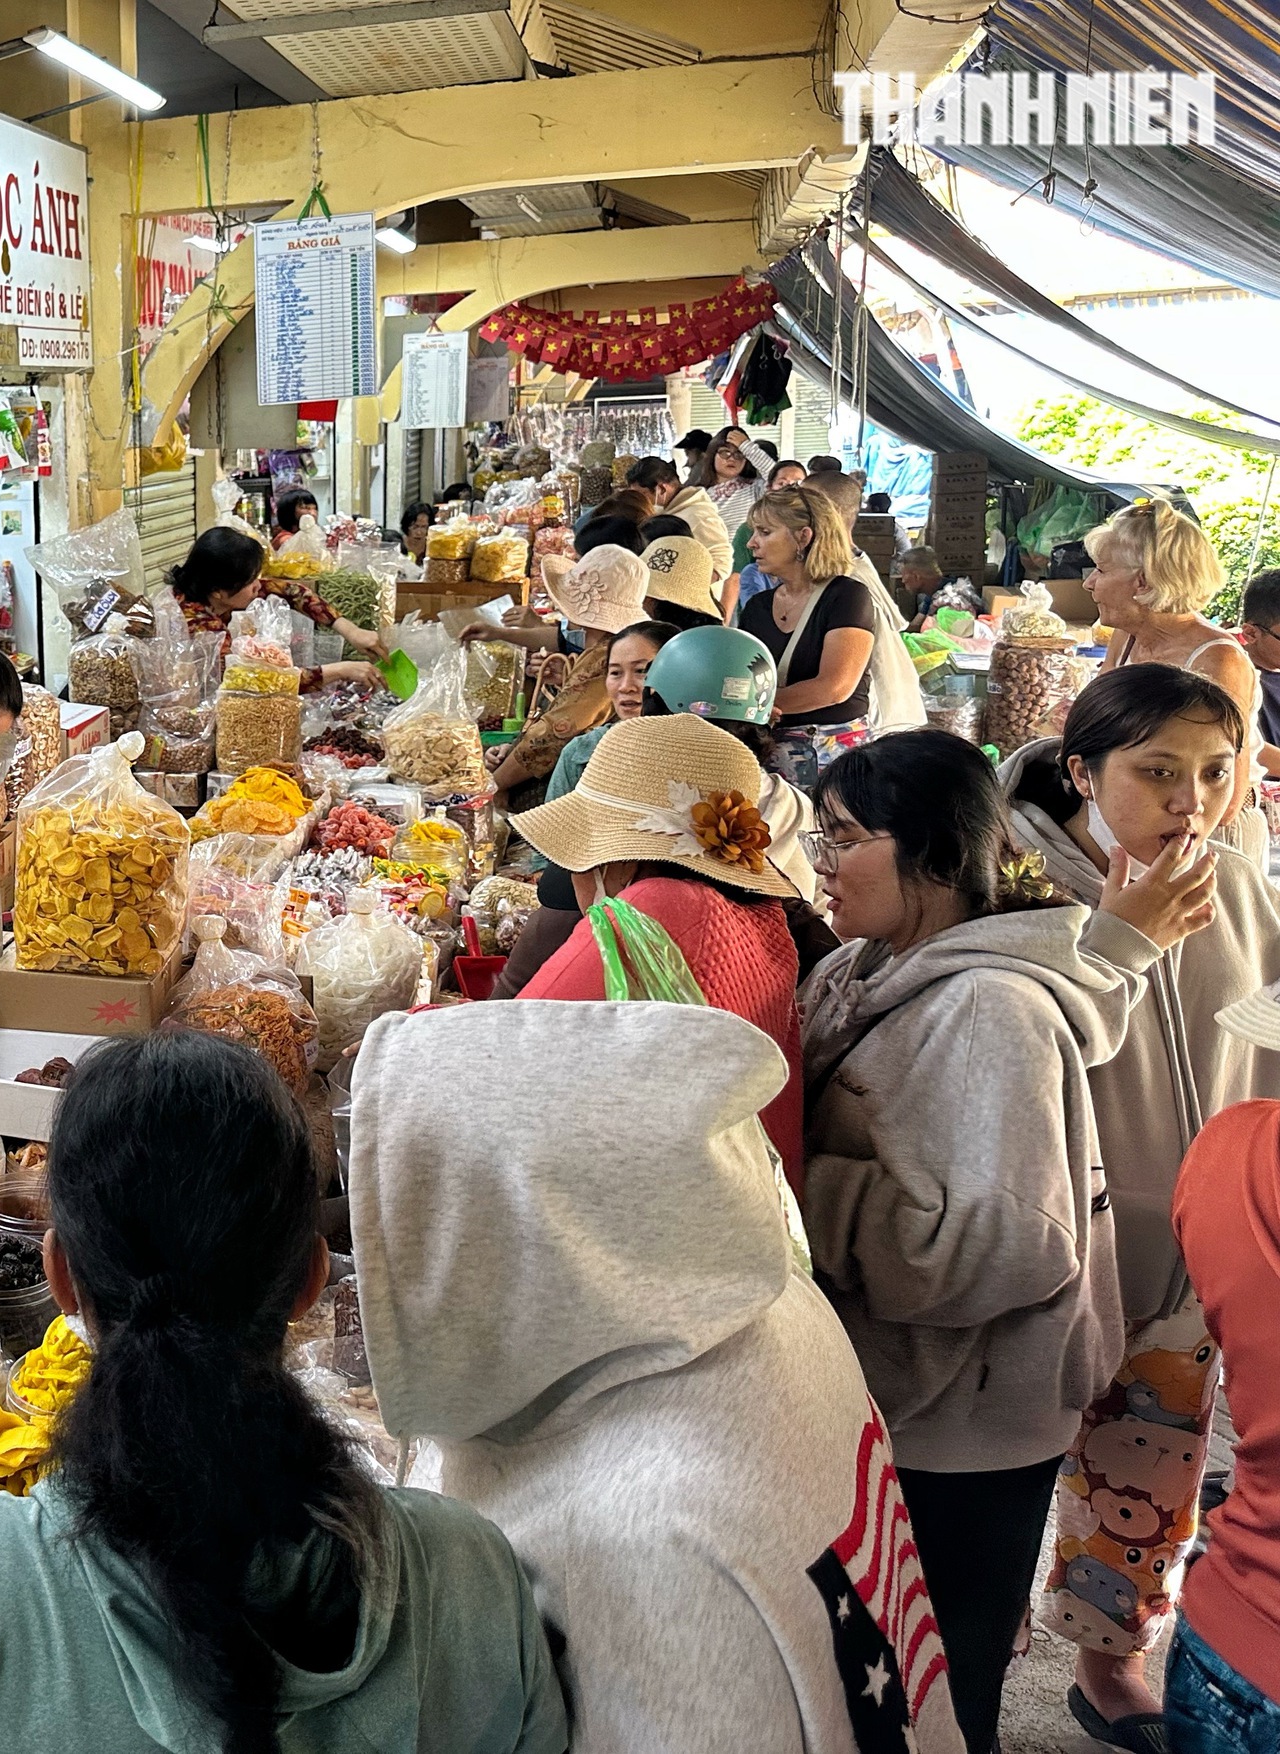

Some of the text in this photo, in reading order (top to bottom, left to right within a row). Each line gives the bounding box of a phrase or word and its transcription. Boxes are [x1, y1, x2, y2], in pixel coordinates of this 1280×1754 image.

[31, 160, 82, 260] ÁNH
[287, 235, 341, 251] BẢNG GIÁ
[17, 279, 41, 318] BIẾN
[45, 282, 56, 318] SỈ
[59, 292, 68, 319] &
[70, 286, 83, 321] LẺ
[21, 337, 39, 358] DĐ:
